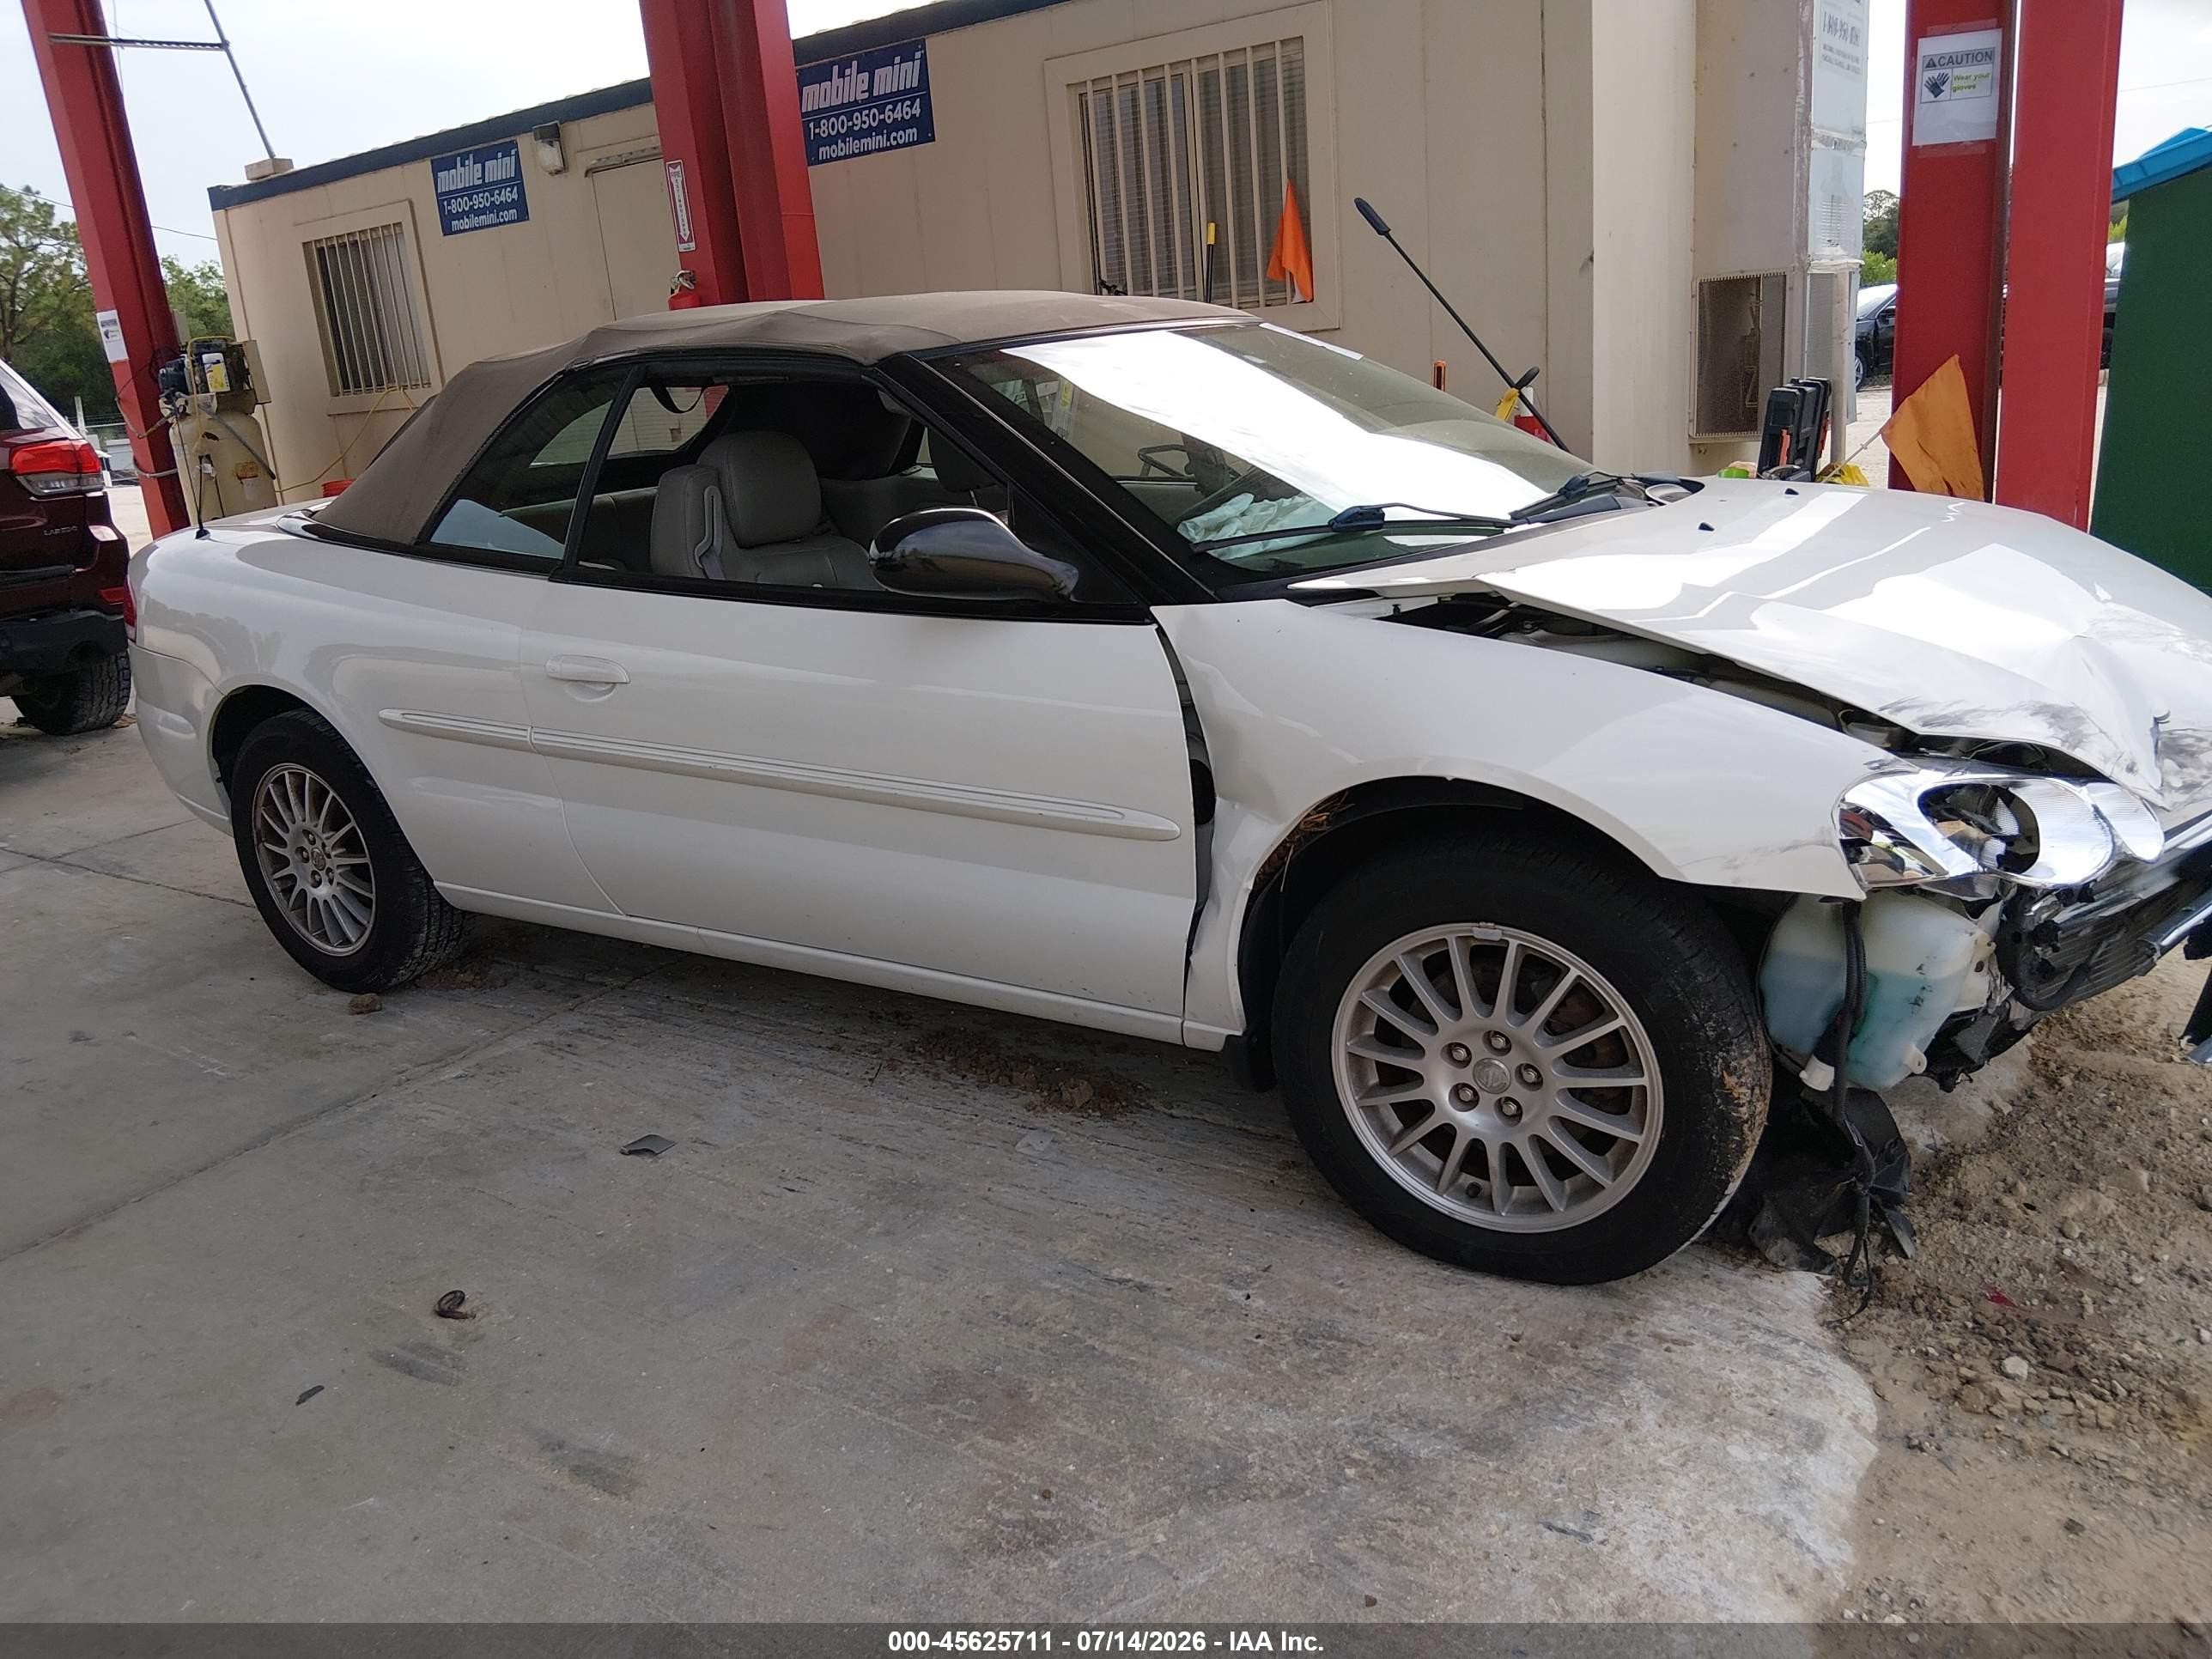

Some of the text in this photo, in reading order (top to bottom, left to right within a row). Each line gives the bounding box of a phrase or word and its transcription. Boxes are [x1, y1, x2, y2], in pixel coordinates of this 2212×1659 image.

[1938, 52, 1993, 66] CAUTION
[801, 51, 921, 112] mobile mini
[809, 98, 921, 140] 1-800-950-6464
[818, 127, 918, 161] mobilemini.com
[437, 149, 516, 193] mobile mini
[443, 185, 519, 215] 1-800-950-6464
[452, 209, 518, 232] mobilemini.com
